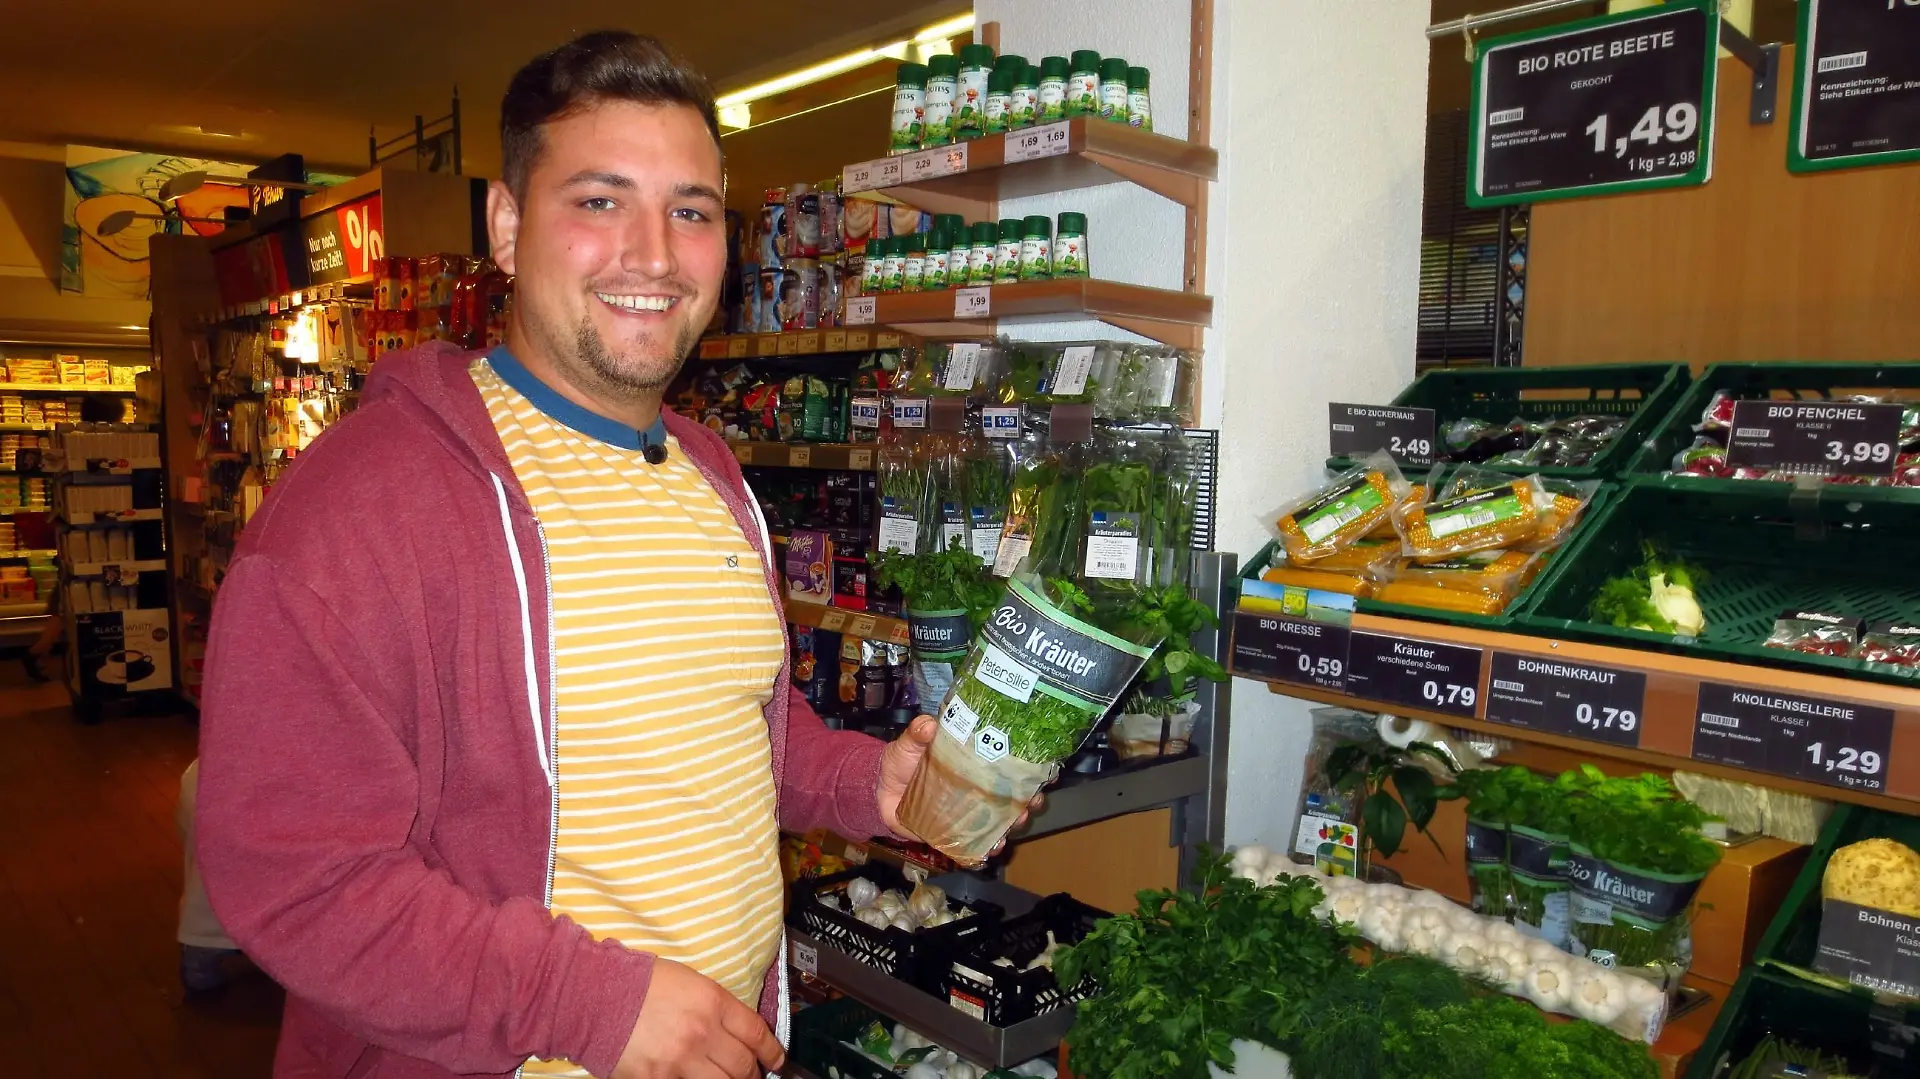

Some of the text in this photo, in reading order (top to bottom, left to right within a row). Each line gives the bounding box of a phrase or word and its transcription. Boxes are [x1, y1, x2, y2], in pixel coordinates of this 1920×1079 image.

[1518, 31, 1675, 75] BIO ROTE BEETE
[1570, 75, 1613, 90] GEKOCHT
[1820, 76, 1889, 91] Kennzeichnung:
[1820, 90, 1843, 100] Siehe
[1845, 87, 1872, 97] Etikett
[1887, 83, 1901, 91] der
[1585, 102, 1697, 158] 1,49
[1628, 159, 1635, 171] 1
[1638, 155, 1653, 171] kg
[1669, 151, 1695, 168] 2,98
[308, 238, 320, 253] Nur
[322, 231, 337, 249] noch
[311, 250, 344, 273] kurze Zeit!
[998, 417, 1015, 427] 1,29
[1354, 408, 1366, 416] BIO
[1368, 409, 1415, 420] ZUCKERMAIS
[1768, 406, 1866, 420] BIO FENCHEL
[1390, 436, 1430, 456] 2,49
[1825, 440, 1890, 465] 3,99
[94, 626, 122, 634] BLACK
[914, 624, 953, 640] Kräuter
[1260, 619, 1322, 637] BIO KRESSE
[995, 605, 1098, 677] Bio Kräuter
[1394, 642, 1435, 659] Kräuter
[981, 656, 1030, 690] Petersilie
[1298, 654, 1342, 677] 0,59
[1377, 655, 1450, 672] verschiedene Sorten
[1518, 659, 1616, 684] BOHNENKRAUT
[1423, 680, 1476, 706] 0,79
[1732, 692, 1854, 720] KNOLLENSELLERIE
[1576, 703, 1636, 732] 0,79
[1770, 714, 1804, 727] KLASSE
[1783, 729, 1795, 737] 1kg
[1806, 742, 1881, 774] 1,29
[1844, 775, 1854, 786] kg
[1863, 779, 1880, 789] 1,29
[1594, 870, 1655, 904] Kräuter
[1858, 910, 1911, 931] Bohnen
